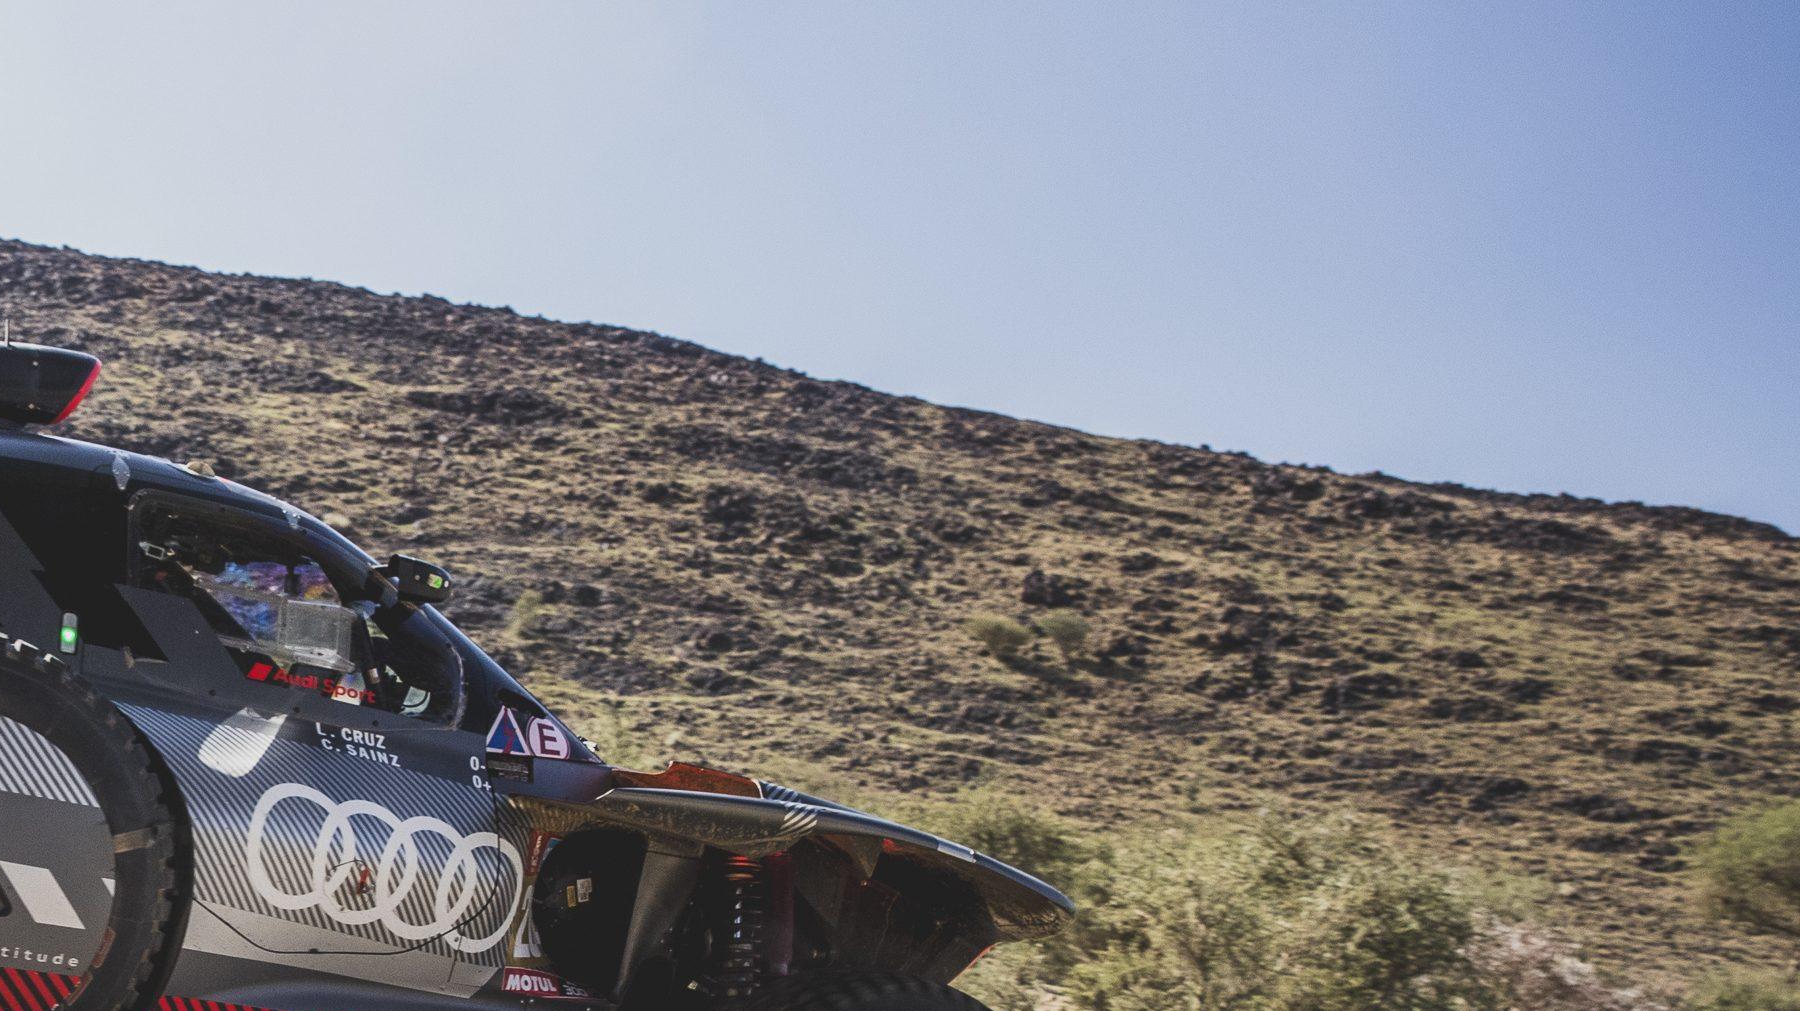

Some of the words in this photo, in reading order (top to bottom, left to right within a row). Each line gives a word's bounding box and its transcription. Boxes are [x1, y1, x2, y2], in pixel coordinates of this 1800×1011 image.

[273, 668, 318, 689] Audi
[322, 678, 376, 703] Sport
[341, 727, 386, 749] CRUZ
[537, 723, 560, 755] E
[345, 743, 400, 767] SAINZ
[505, 974, 558, 992] MOTUL
